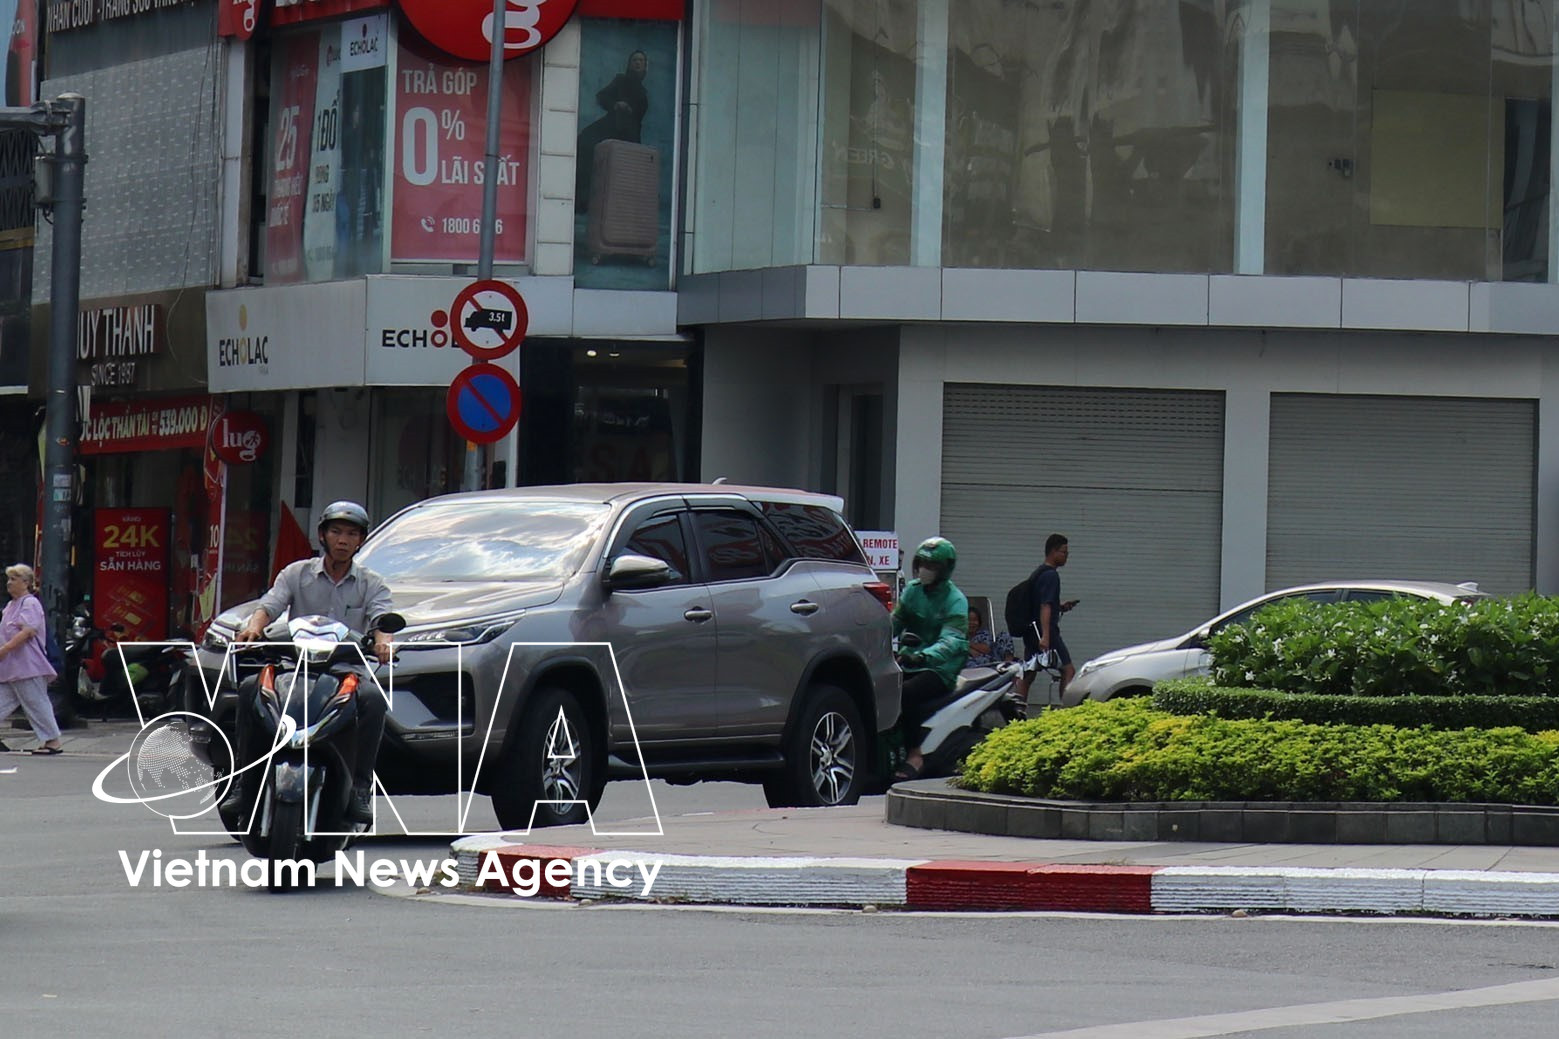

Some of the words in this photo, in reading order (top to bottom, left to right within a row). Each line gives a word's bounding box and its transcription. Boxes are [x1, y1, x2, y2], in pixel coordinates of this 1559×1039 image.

[349, 35, 380, 58] ECHOLAC
[401, 63, 438, 95] TRẢ
[442, 67, 478, 96] GÓP
[275, 105, 300, 174] 25
[441, 156, 469, 185] LÃI
[473, 154, 521, 186] SẤT
[442, 217, 470, 234] 1800
[488, 311, 506, 323] 3.5t
[102, 304, 155, 357] THANH
[219, 335, 269, 367] ECHOLAC
[91, 362, 116, 386] SINCE
[159, 406, 198, 437] 539.000
[222, 418, 262, 462] lug
[102, 524, 161, 549] 24K
[863, 538, 898, 550] REMOTE
[126, 557, 162, 572] HÀNG
[878, 555, 890, 566] XE
